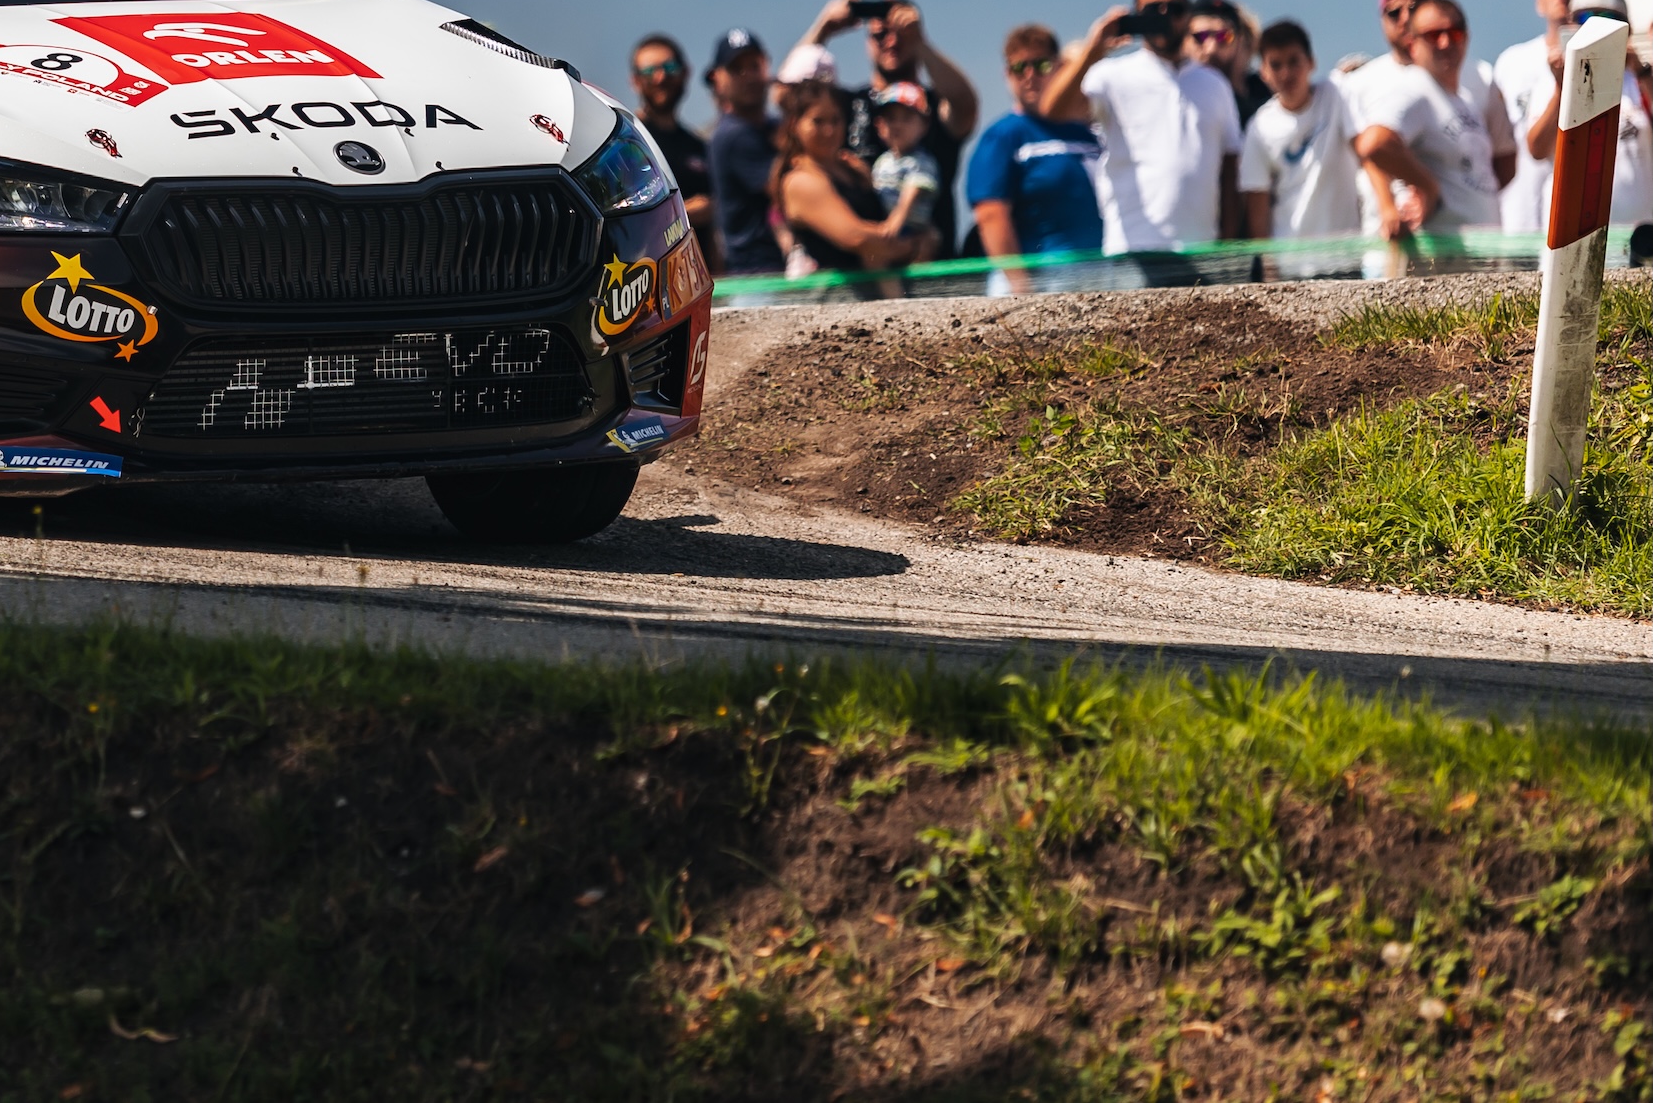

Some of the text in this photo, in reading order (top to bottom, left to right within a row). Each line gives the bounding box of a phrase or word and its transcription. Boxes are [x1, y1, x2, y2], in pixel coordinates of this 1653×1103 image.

[30, 52, 83, 71] 8
[171, 49, 335, 68] ORLEN
[22, 68, 129, 102] POLAND
[612, 269, 649, 321] LOTTO
[48, 284, 135, 333] LOTTO
[631, 424, 665, 440] MICHELIN
[9, 455, 109, 469] MICHELIN
